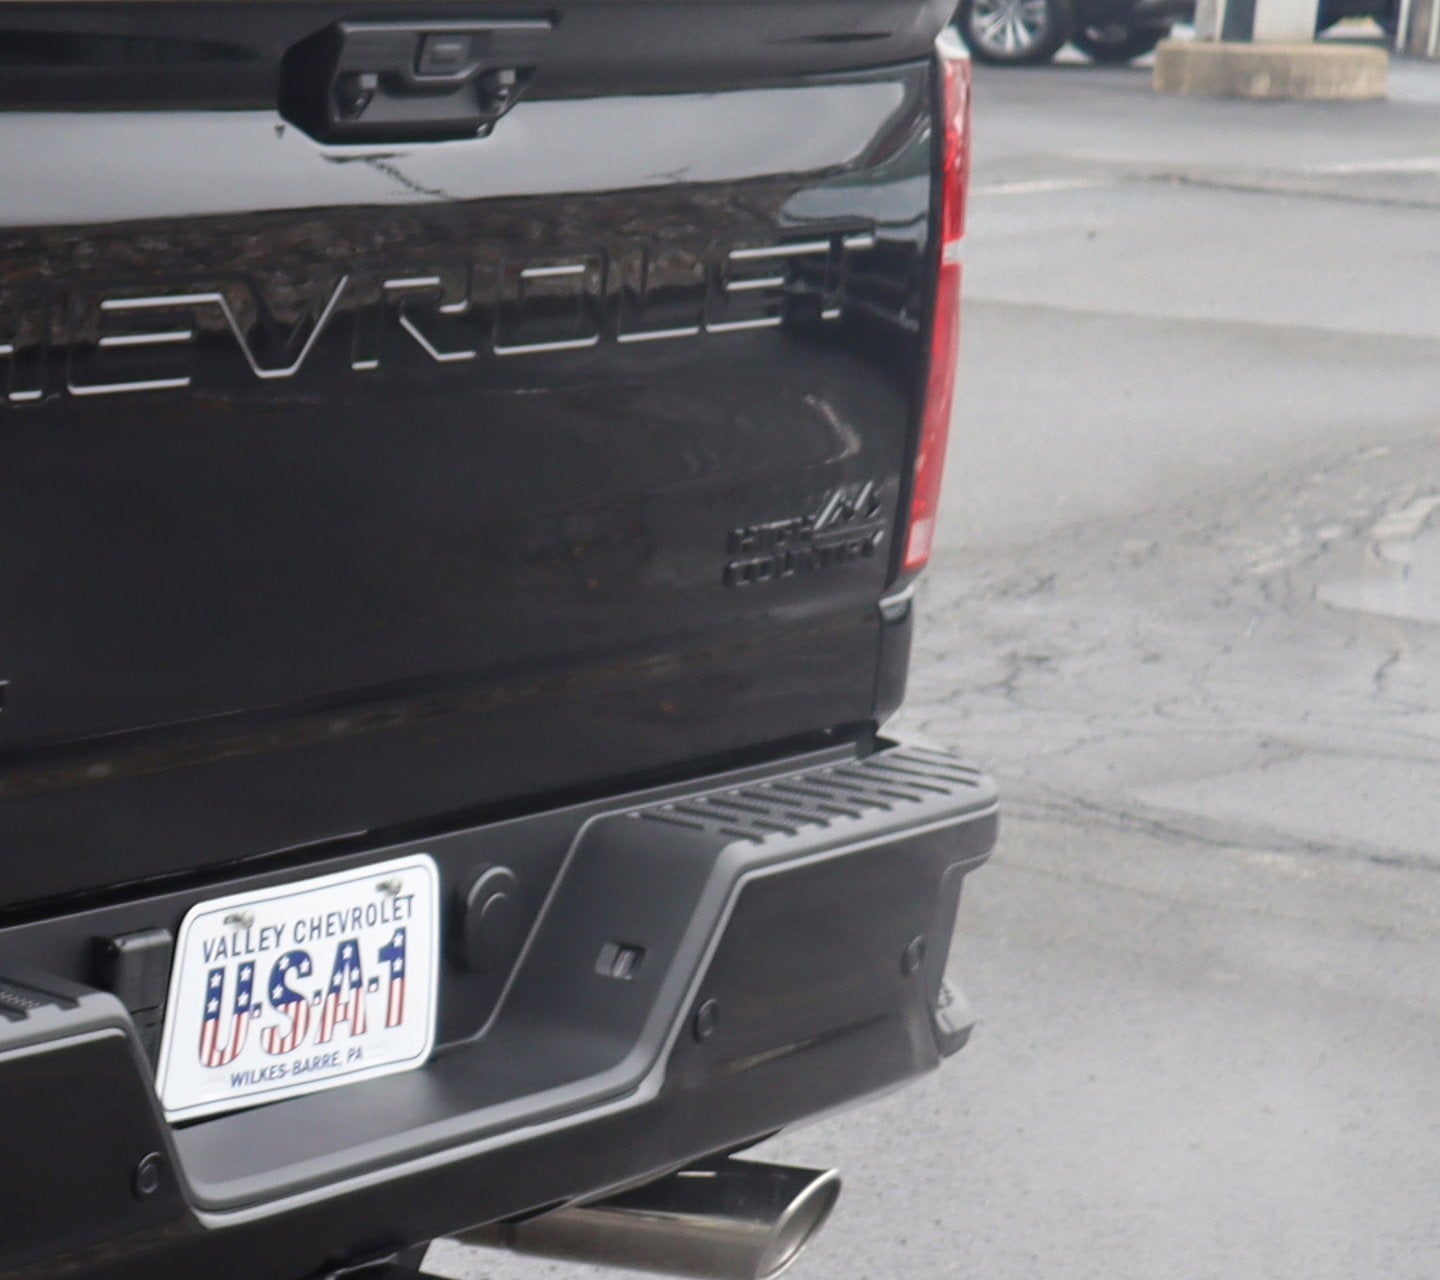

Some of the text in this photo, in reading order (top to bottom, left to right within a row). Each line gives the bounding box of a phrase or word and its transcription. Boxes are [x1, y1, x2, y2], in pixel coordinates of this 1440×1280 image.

[201, 894, 415, 963] VALLEY CHEVROLET
[229, 1047, 364, 1089] WILKES-BARRE, PA
